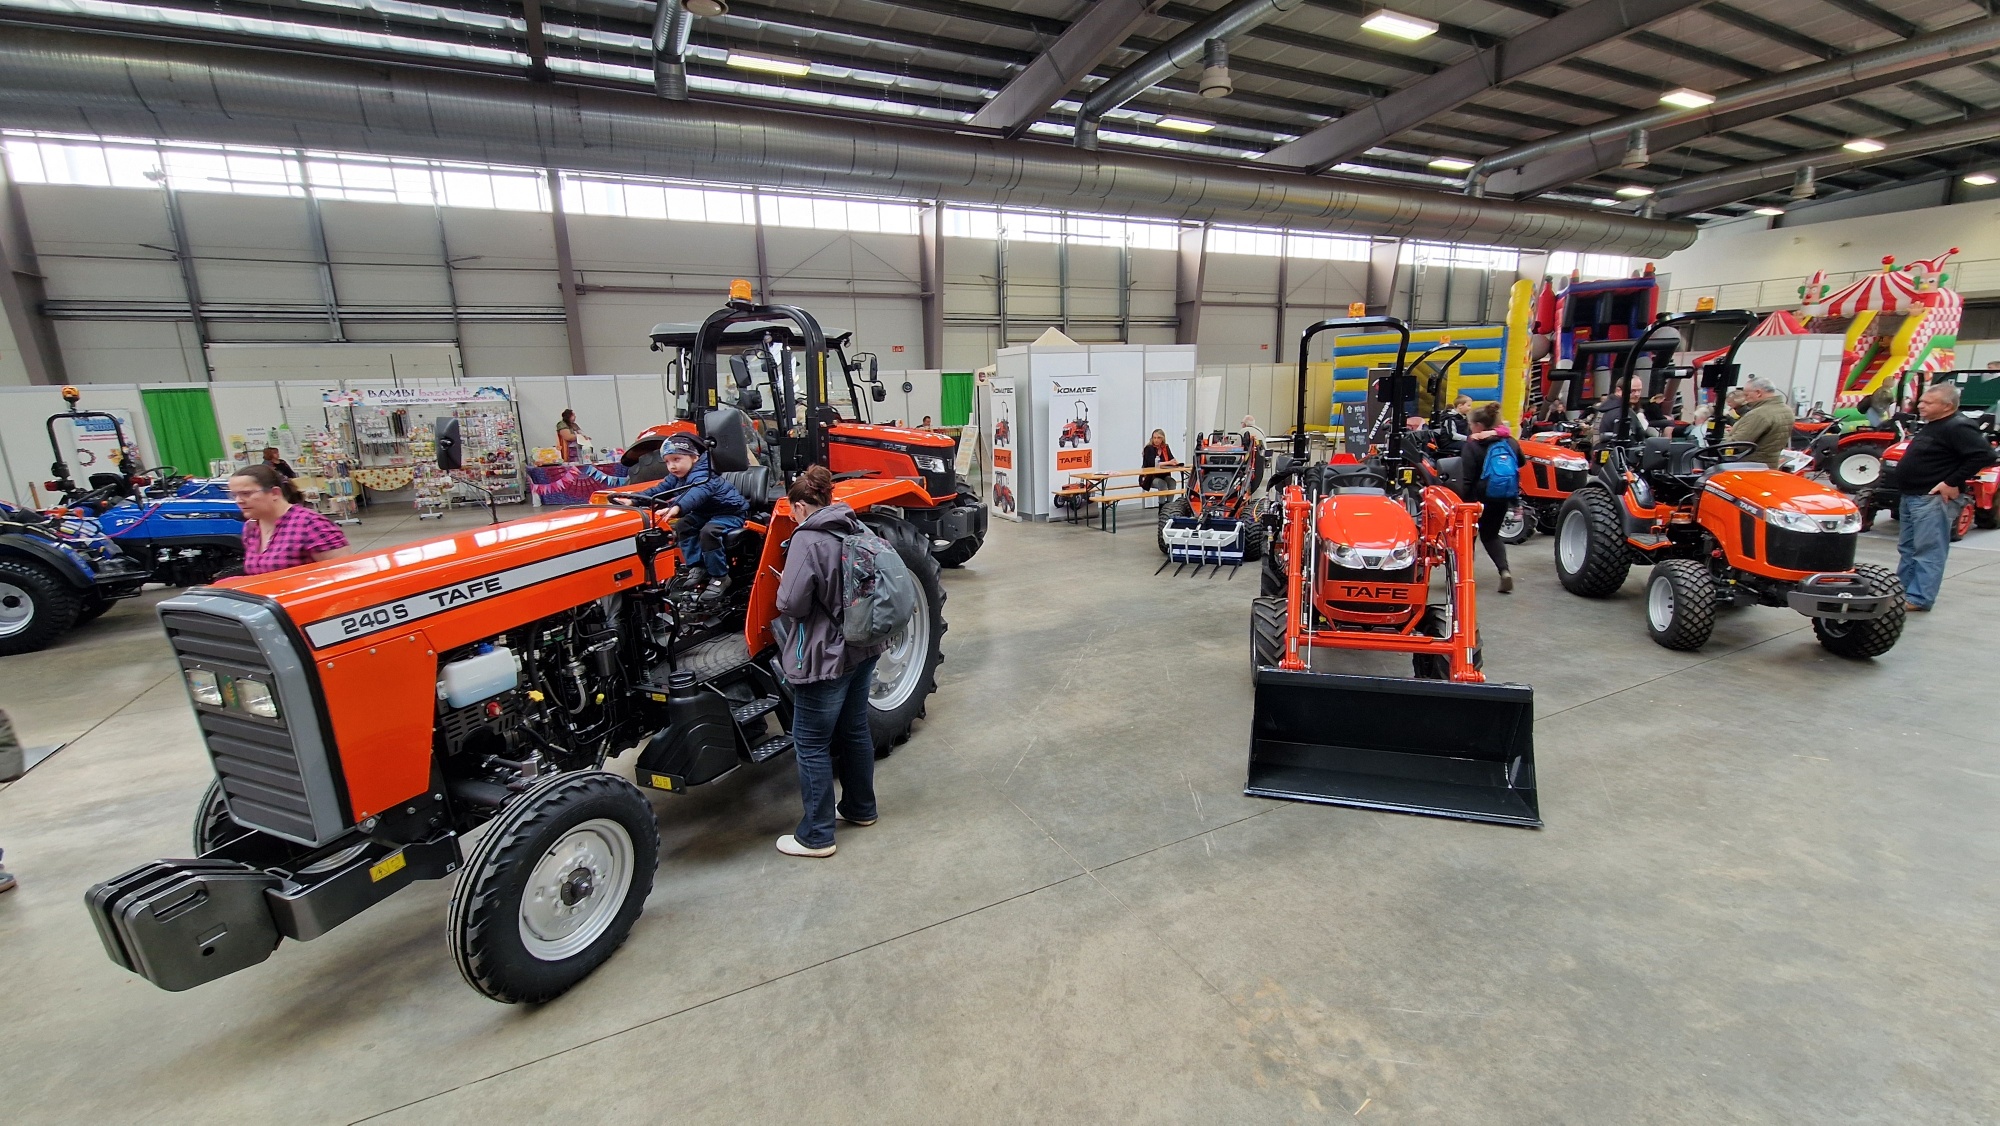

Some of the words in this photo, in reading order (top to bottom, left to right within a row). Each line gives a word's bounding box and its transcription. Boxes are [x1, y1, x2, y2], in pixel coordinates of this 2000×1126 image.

[1058, 386, 1097, 394] KOMATEC
[884, 442, 907, 452] TAFE
[1059, 456, 1082, 464] TAFE
[1740, 501, 1758, 514] TAFE
[1341, 586, 1408, 600] TAFE
[341, 610, 390, 636] 240
[392, 604, 409, 620] S
[429, 577, 502, 606] TAFE
